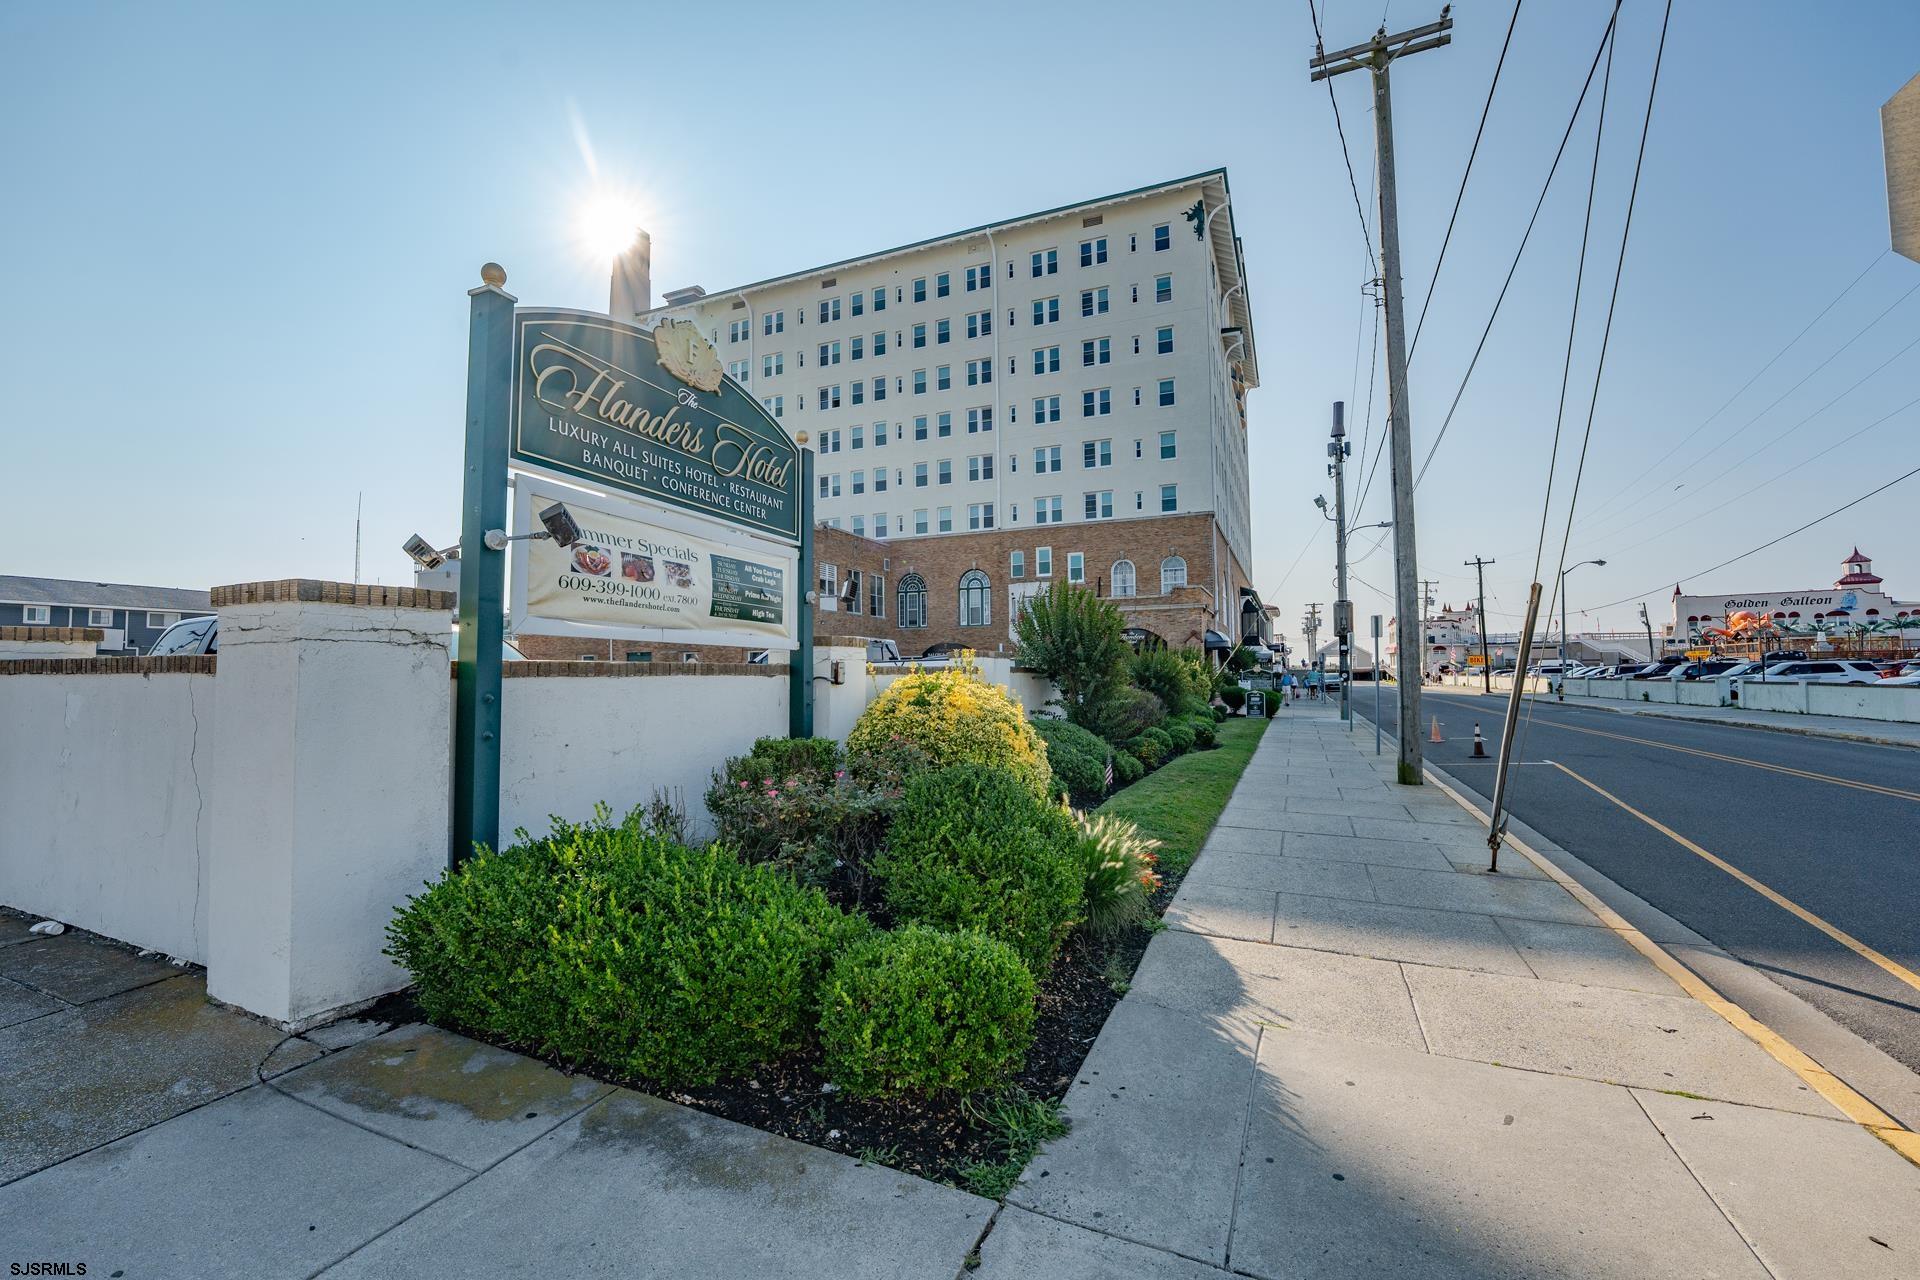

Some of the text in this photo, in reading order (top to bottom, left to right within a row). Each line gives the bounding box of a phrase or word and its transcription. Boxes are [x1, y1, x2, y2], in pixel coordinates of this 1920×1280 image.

[677, 388, 698, 409] The
[530, 344, 794, 488] Flanders Hotel
[549, 417, 784, 511] LUXURY ALL SUITES HOTEL RESTAURANT
[583, 448, 767, 520] BANQUET CONFERENCE CENTER
[580, 528, 699, 563] mmer Specials
[752, 574, 765, 583] Crab
[753, 566, 762, 575] You
[558, 574, 661, 601] 609-399-1000
[583, 595, 681, 613] www.theflandershotel.com
[1724, 596, 1833, 609] Golden Galleon
[752, 609, 775, 619] High Tea
